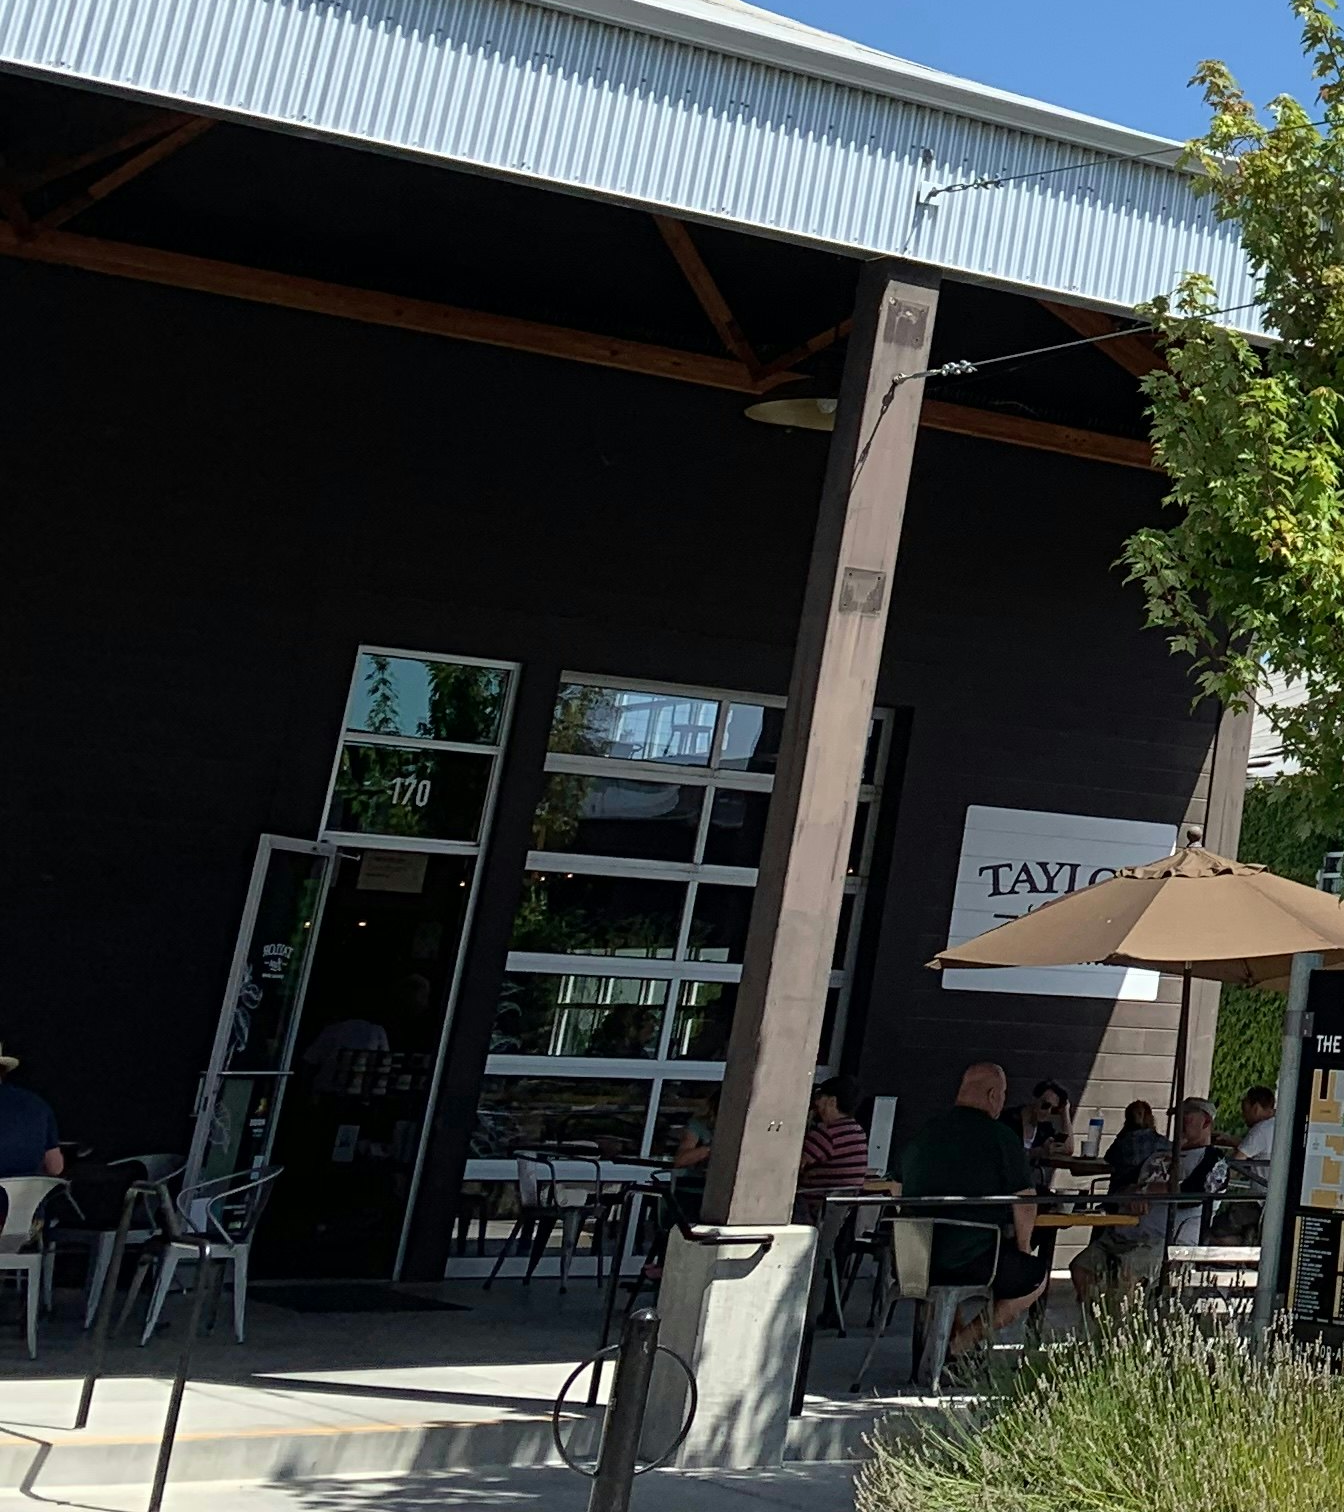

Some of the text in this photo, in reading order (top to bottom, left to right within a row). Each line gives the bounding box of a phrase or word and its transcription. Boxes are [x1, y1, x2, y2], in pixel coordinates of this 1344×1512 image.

[391, 776, 431, 807] 170
[978, 861, 1117, 898] TAYLO
[1316, 1035, 1342, 1053] THE
